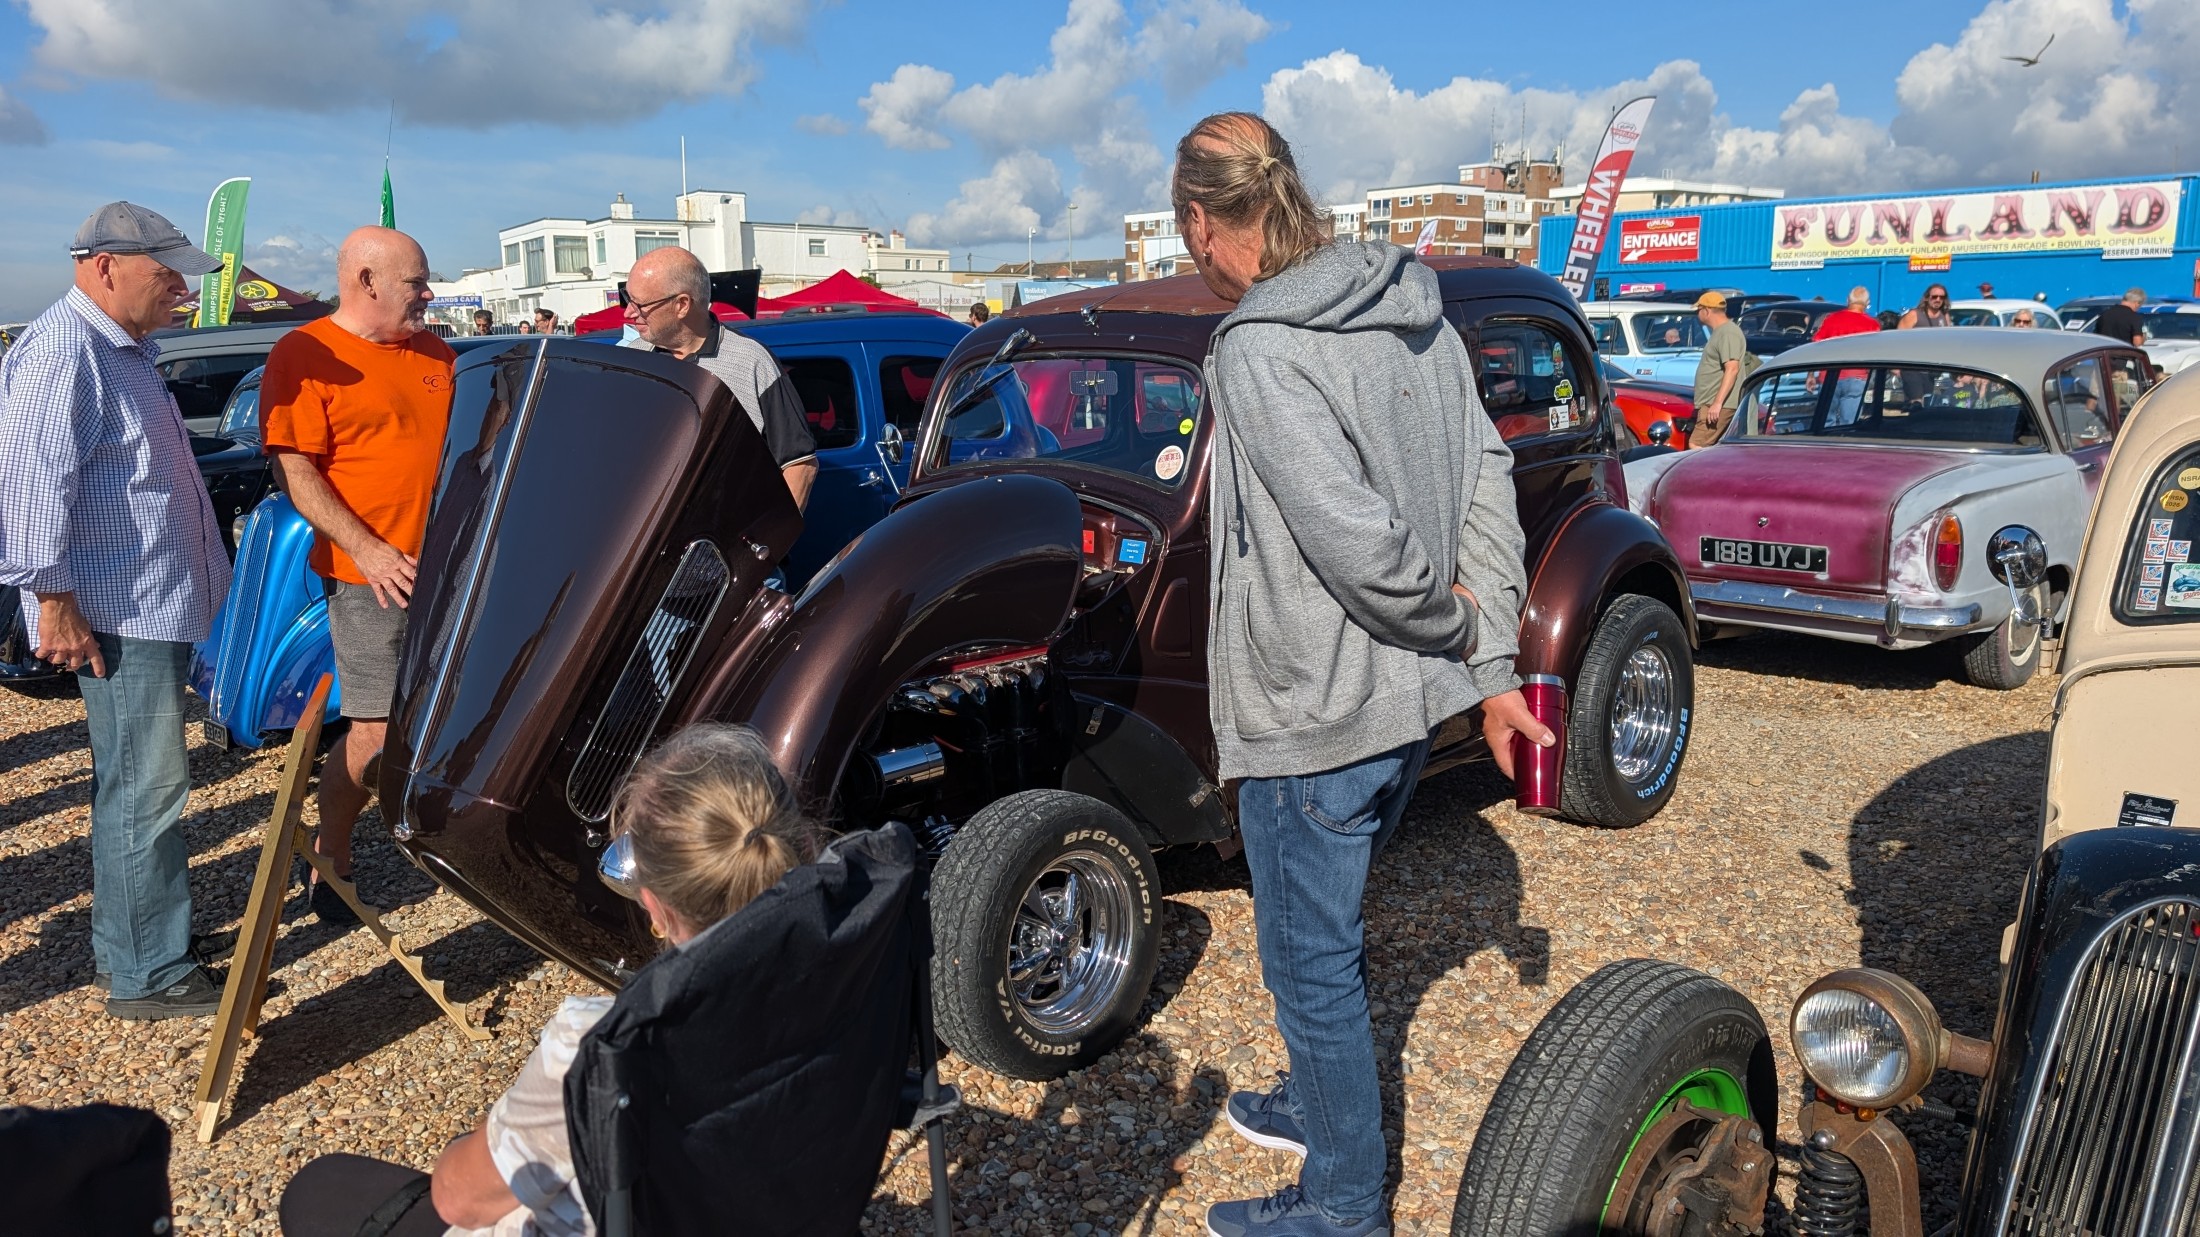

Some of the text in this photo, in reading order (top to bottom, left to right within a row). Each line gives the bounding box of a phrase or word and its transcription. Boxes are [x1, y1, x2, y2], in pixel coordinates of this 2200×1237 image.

[214, 196, 227, 257] ISLE OF WIGHT
[1778, 187, 2171, 250] FUNLAND
[1623, 231, 1697, 249] ENTRANCE
[1830, 249, 1860, 257] INDOOR
[1883, 247, 1904, 255] AREA
[1911, 246, 1949, 254] FUNLAND
[1951, 243, 2009, 252] AMUSEMENTS
[2011, 241, 2048, 250] ARCADE
[2058, 240, 2100, 248] BOWLING
[2108, 238, 2135, 247] OPEN
[2137, 237, 2165, 246] DAILY
[2103, 247, 2173, 257] RESERVED PARKING
[222, 255, 233, 304] AMBULANCE
[1771, 260, 1799, 268] RESERVED
[1911, 258, 1949, 266] ENTRANCE
[210, 276, 218, 324] HAMPSHIRE
[1024, 288, 1047, 296] Holiday
[1714, 541, 1811, 570] 188 UYJ
[1637, 708, 1689, 799] BFGoodrich
[1063, 829, 1153, 925] BFGoodrich
[996, 976, 1081, 1056] Radial T/A
